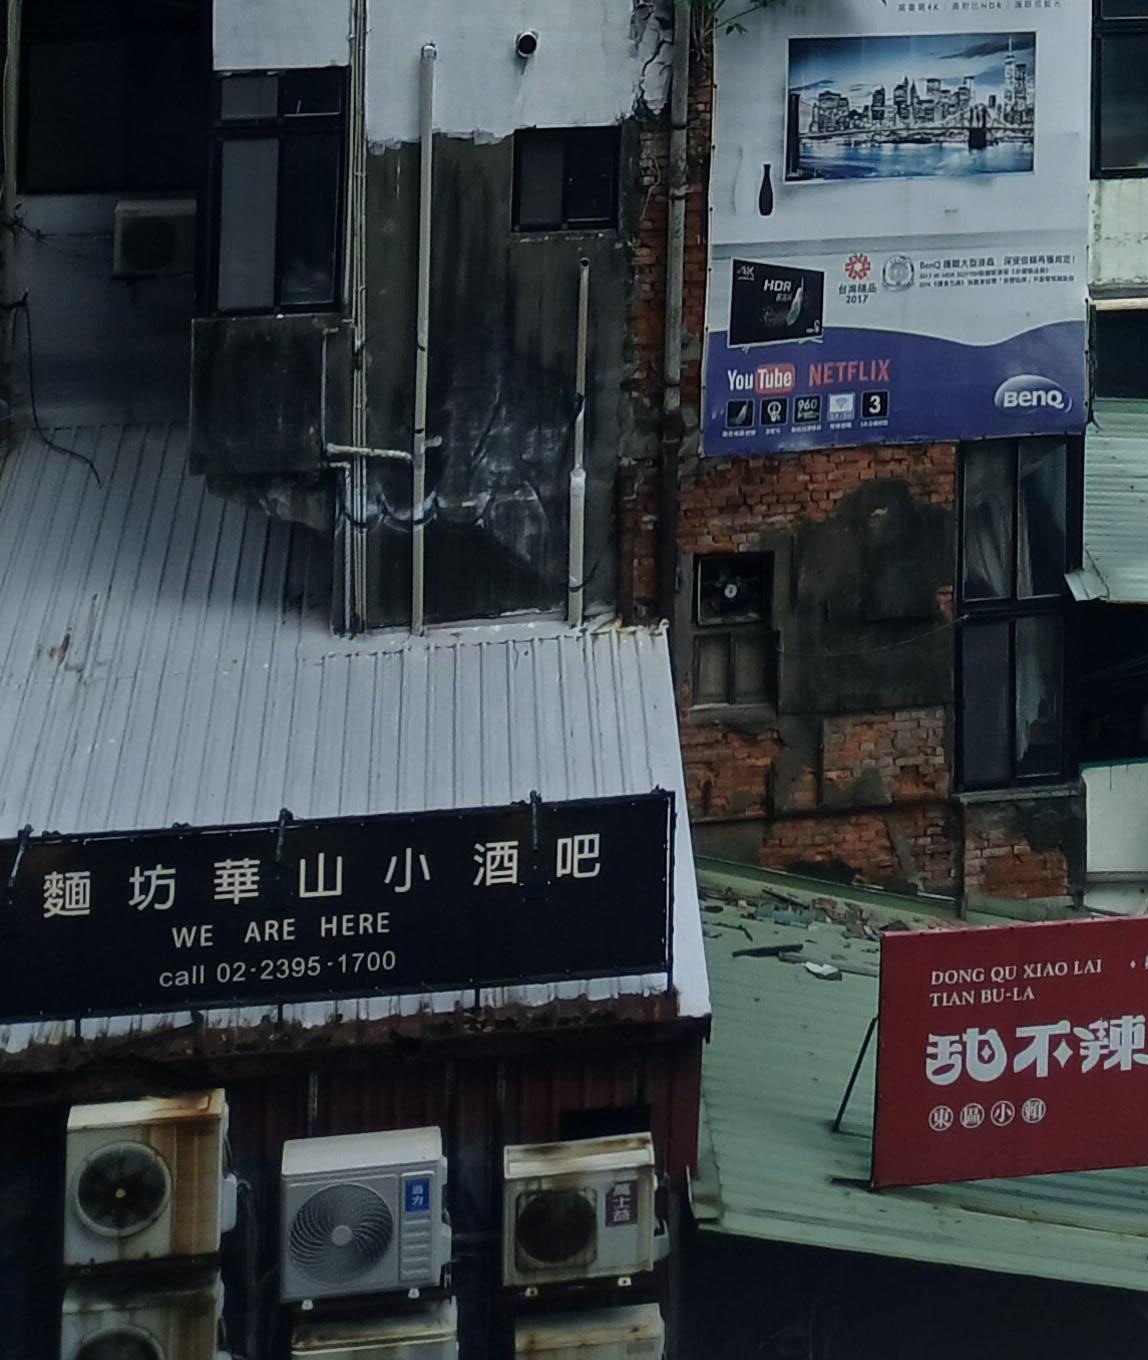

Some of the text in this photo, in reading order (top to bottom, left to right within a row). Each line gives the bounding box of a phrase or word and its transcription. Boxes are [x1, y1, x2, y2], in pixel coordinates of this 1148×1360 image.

[763, 279, 792, 292] HDR
[846, 294, 868, 304] 2017
[809, 360, 891, 386] NETFLIX
[798, 399, 818, 411] 960
[869, 395, 881, 414] 3
[1003, 389, 1065, 409] BenQ
[42, 833, 601, 919] 麵坊華山小酒吧
[172, 912, 391, 949] WE ARE HERE
[159, 950, 397, 989] call 02-2395-1700
[931, 959, 1103, 986] DONG QU XIAO LAI
[929, 986, 1035, 1007] TIAN BU-LA
